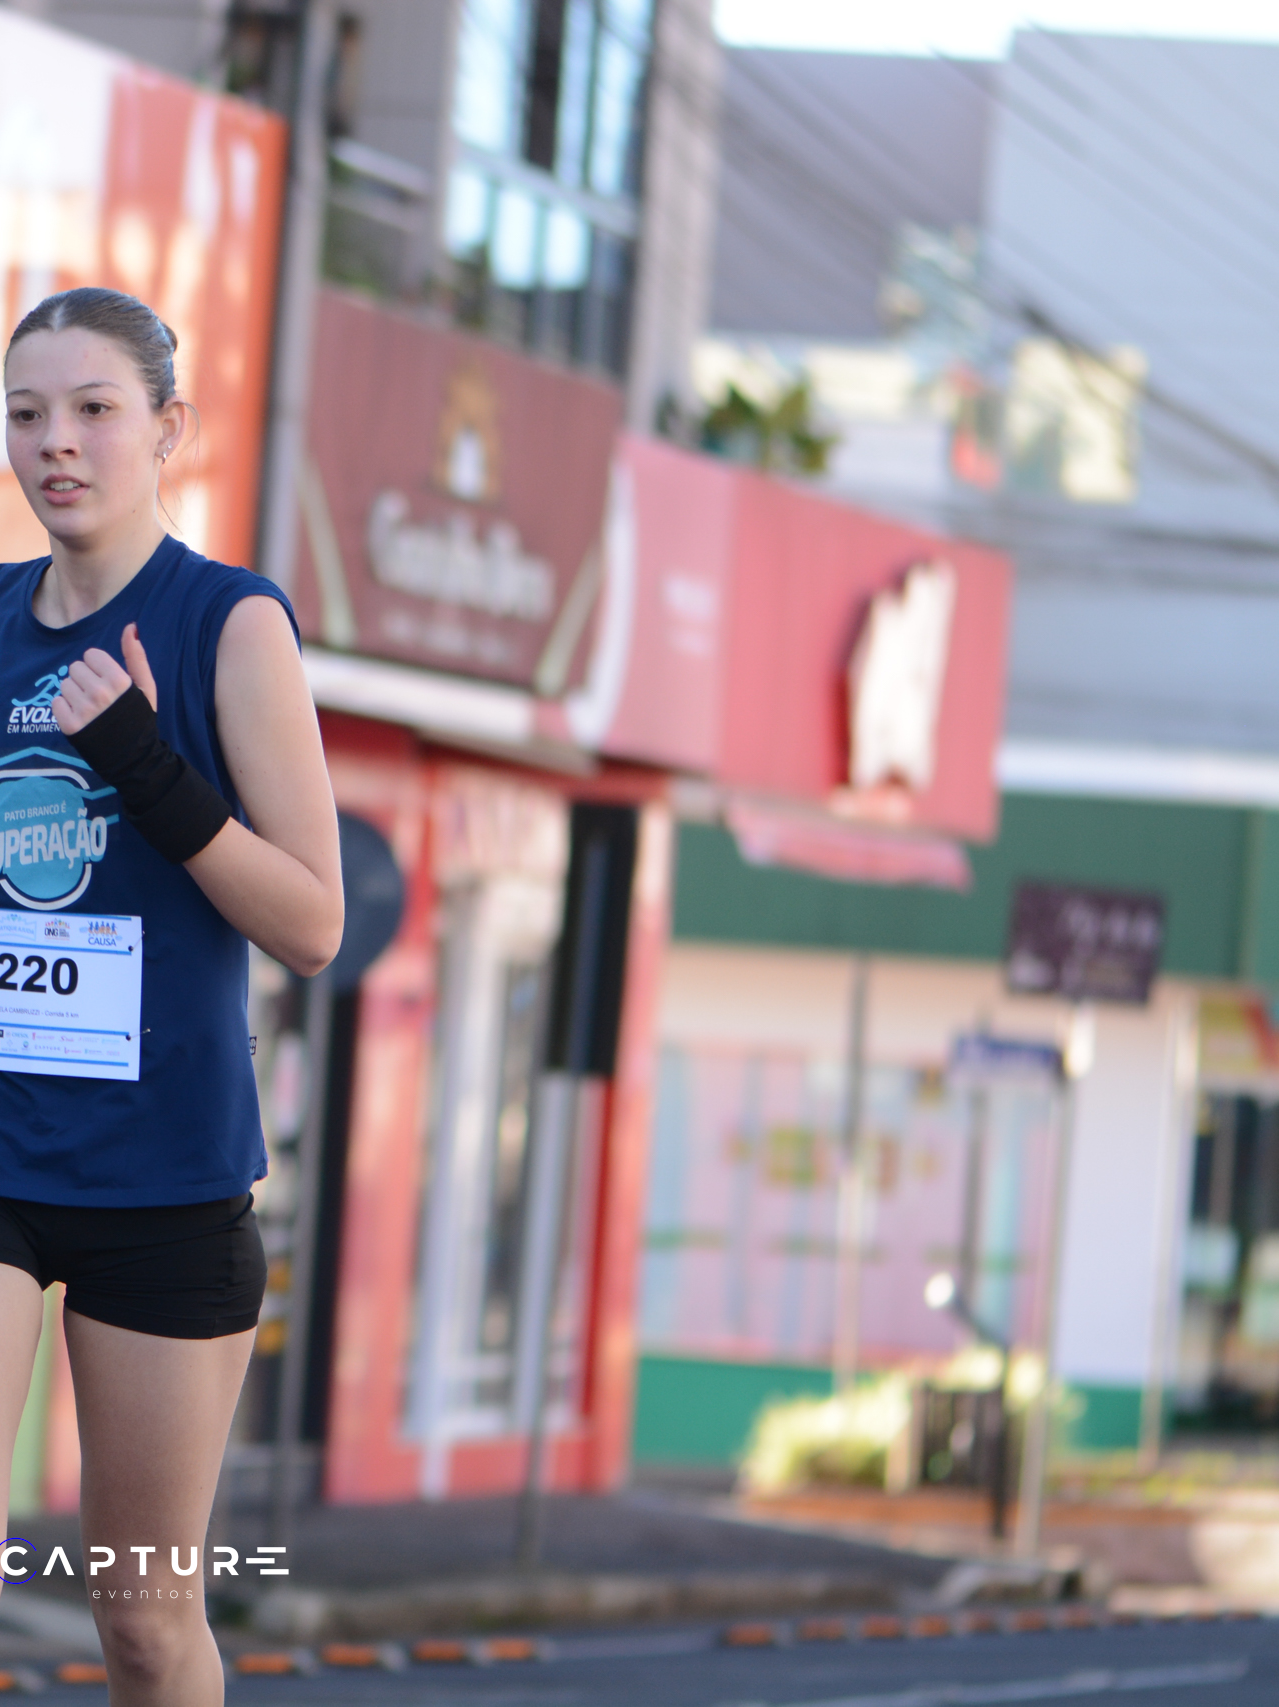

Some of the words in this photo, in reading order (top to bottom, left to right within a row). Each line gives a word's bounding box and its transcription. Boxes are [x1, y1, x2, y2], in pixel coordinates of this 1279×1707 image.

[7, 724, 20, 734] EM
[21, 723, 61, 734] MOVIMEN
[4, 810, 26, 822] PATO
[27, 804, 60, 818] BRANCO
[61, 799, 67, 814] É
[87, 936, 117, 947] CAUSA
